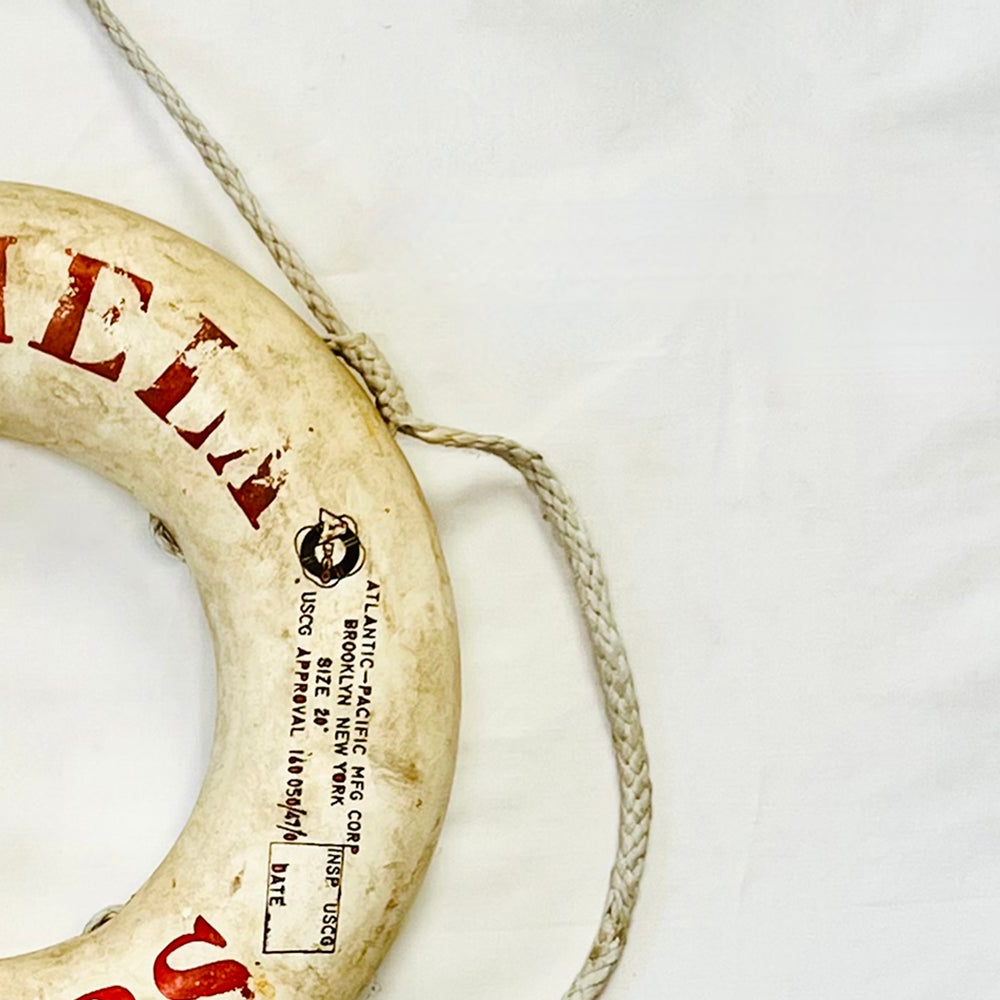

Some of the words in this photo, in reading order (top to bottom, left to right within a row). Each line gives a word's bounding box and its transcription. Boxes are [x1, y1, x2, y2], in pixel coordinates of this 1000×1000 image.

[298, 591, 318, 636] USCG
[314, 656, 333, 697] SIZE
[337, 619, 359, 706] BROOKLYN
[289, 646, 312, 737] APPROVAL
[334, 717, 351, 756] NEW
[330, 761, 348, 806] YORK
[349, 766, 365, 801] MFG
[346, 810, 363, 854] CORP
[268, 863, 290, 907] DATE
[325, 848, 344, 888] INSP
[319, 903, 338, 947] USCG
